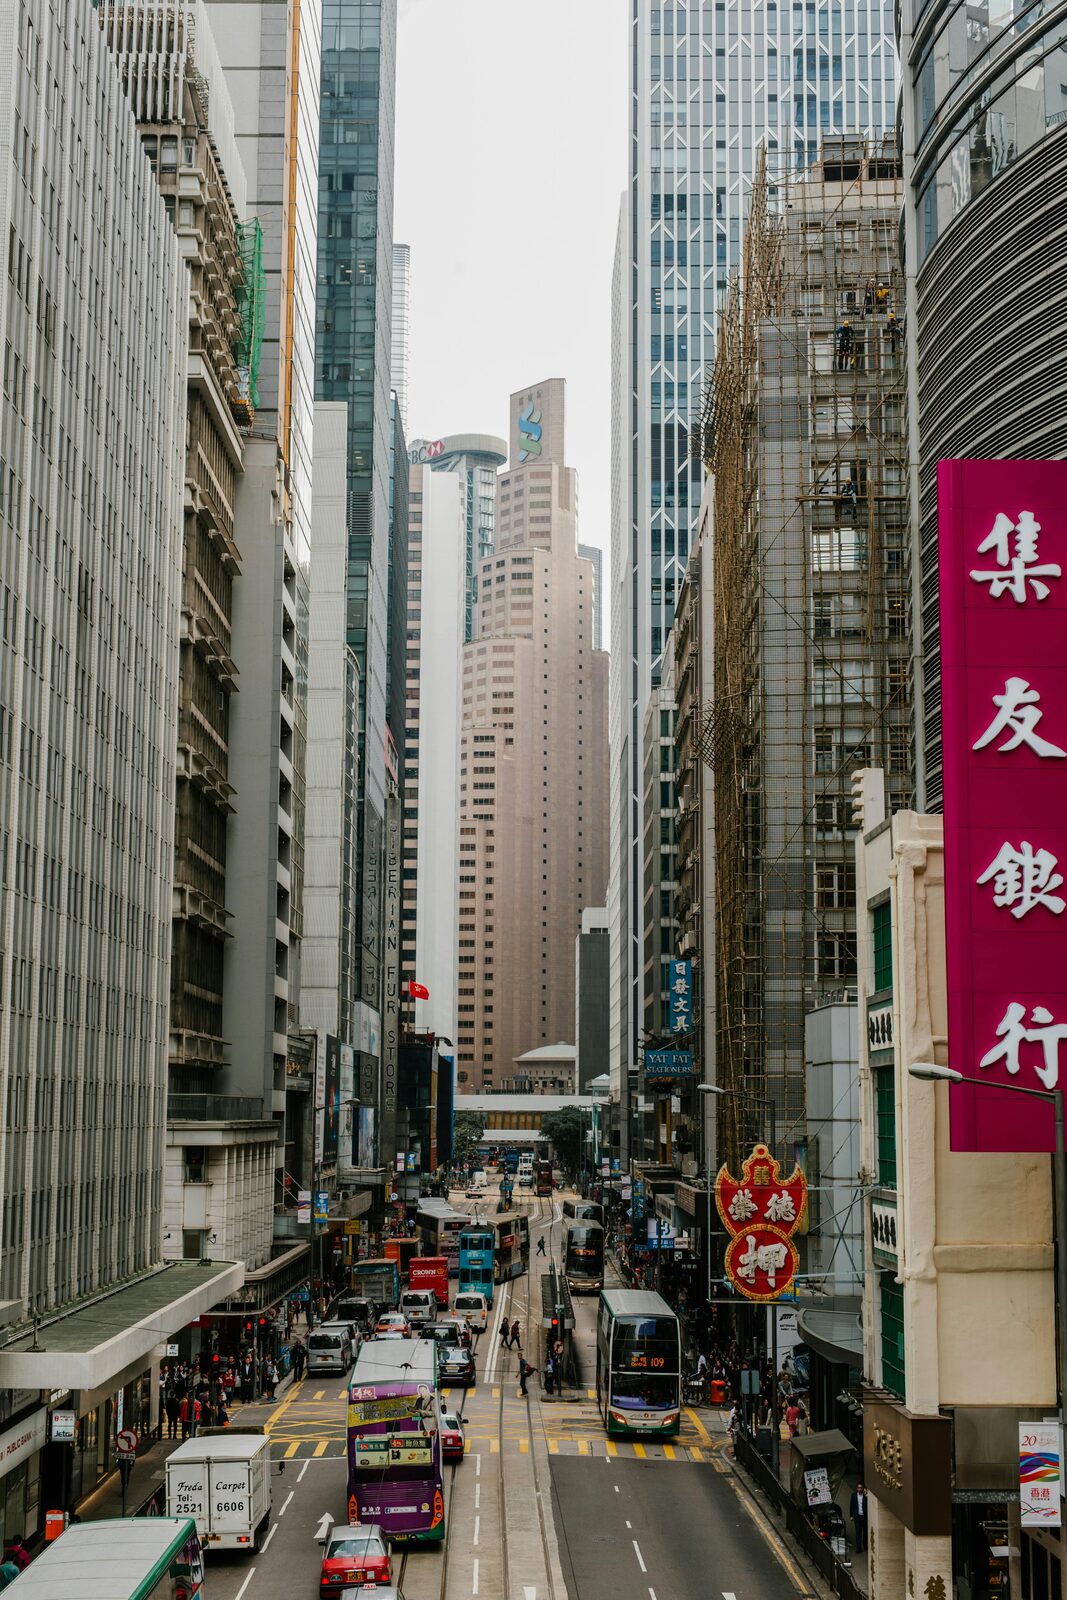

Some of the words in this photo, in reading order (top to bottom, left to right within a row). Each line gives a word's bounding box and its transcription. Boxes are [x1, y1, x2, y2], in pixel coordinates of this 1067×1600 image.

[969, 510, 1067, 1090] 集友銀行
[387, 966, 396, 1014] FUR
[671, 961, 691, 1032] 日發文具
[649, 1054, 668, 1064] YAT
[672, 1054, 691, 1064] FAT
[646, 1066, 692, 1074] STATIONERS
[736, 1234, 789, 1289] 押
[650, 1357, 665, 1368] 109
[21, 1430, 32, 1446] BANK
[1021, 1435, 1037, 1446] 20
[177, 1482, 203, 1492] Freda
[215, 1481, 246, 1492] Carpet
[177, 1494, 193, 1502] Tel:
[1030, 1487, 1051, 1498] 香港
[176, 1503, 202, 1513] 2521
[216, 1501, 244, 1512] 6606
